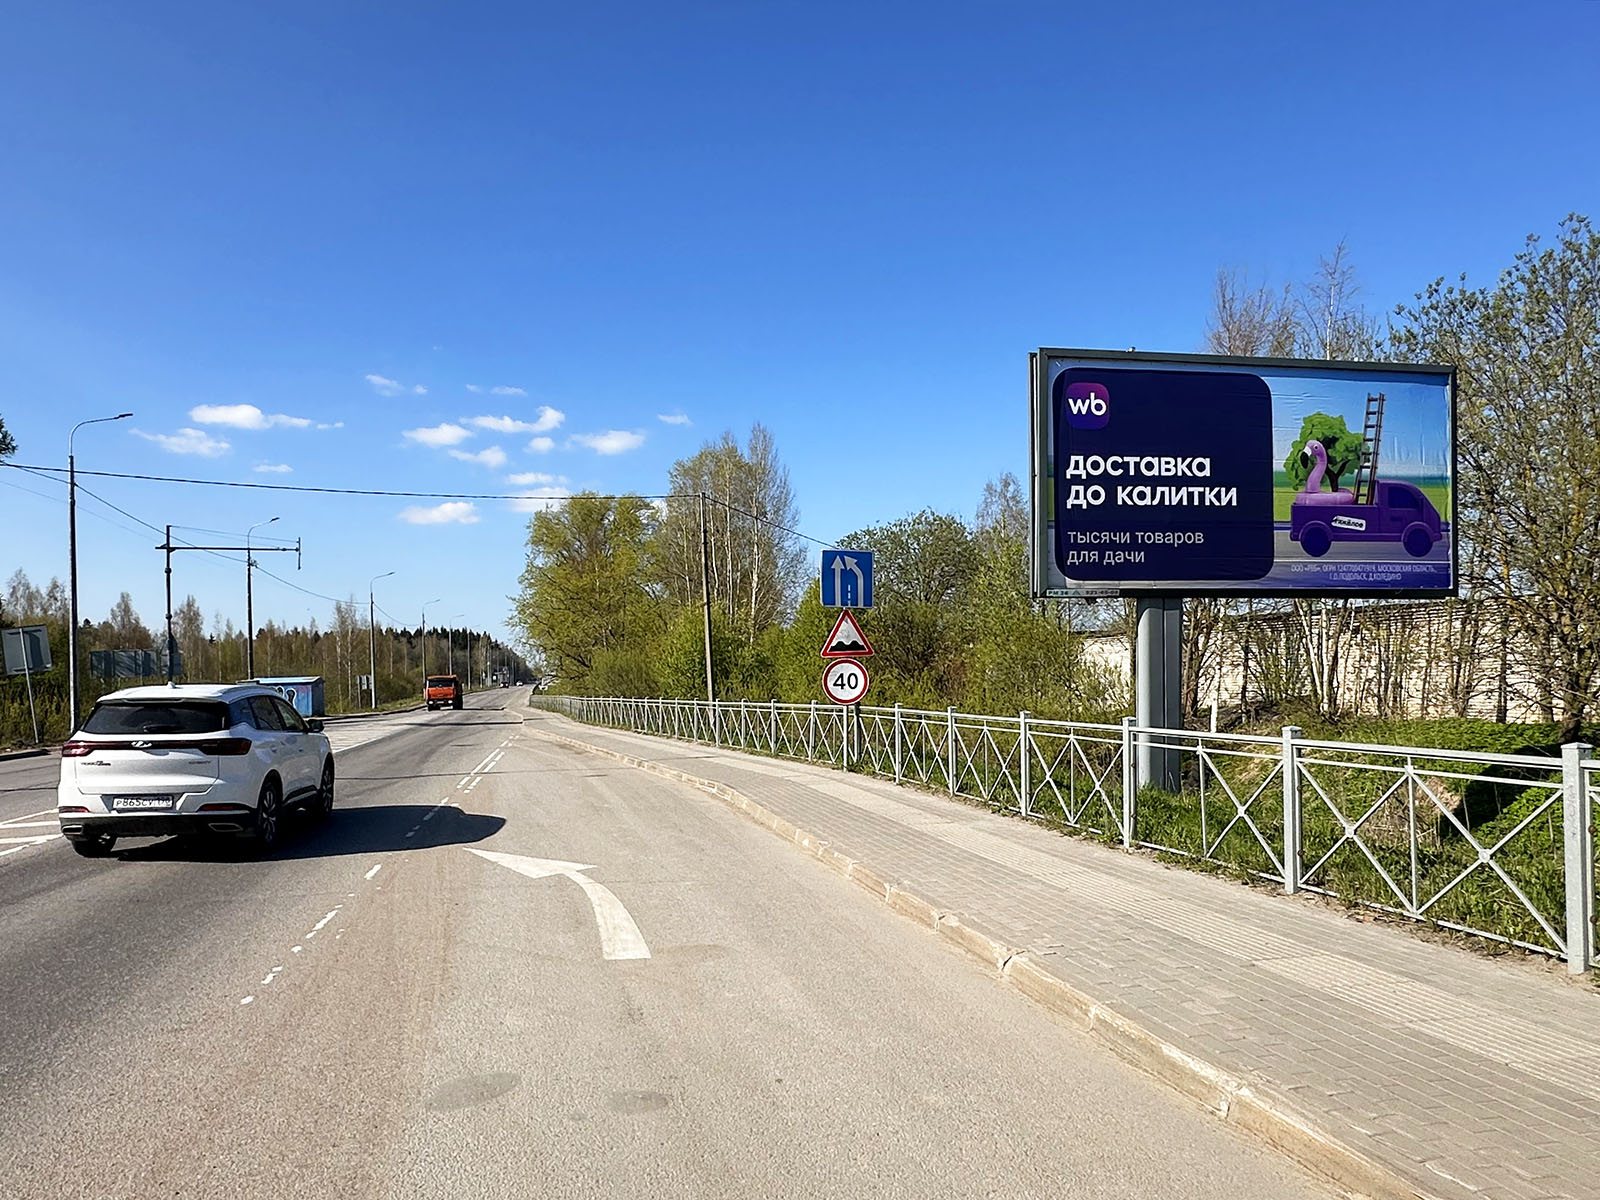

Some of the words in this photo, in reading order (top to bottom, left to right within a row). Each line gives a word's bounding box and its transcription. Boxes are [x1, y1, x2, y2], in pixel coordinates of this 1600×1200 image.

[1068, 393, 1107, 416] wb
[1066, 455, 1211, 479] доставка
[1066, 485, 1106, 509] до
[1117, 486, 1237, 506] калитки
[1067, 531, 1131, 544] тысячи
[1135, 532, 1204, 547] товаров
[1067, 551, 1099, 566] для
[1103, 551, 1145, 566] дачи
[833, 672, 858, 690] 40
